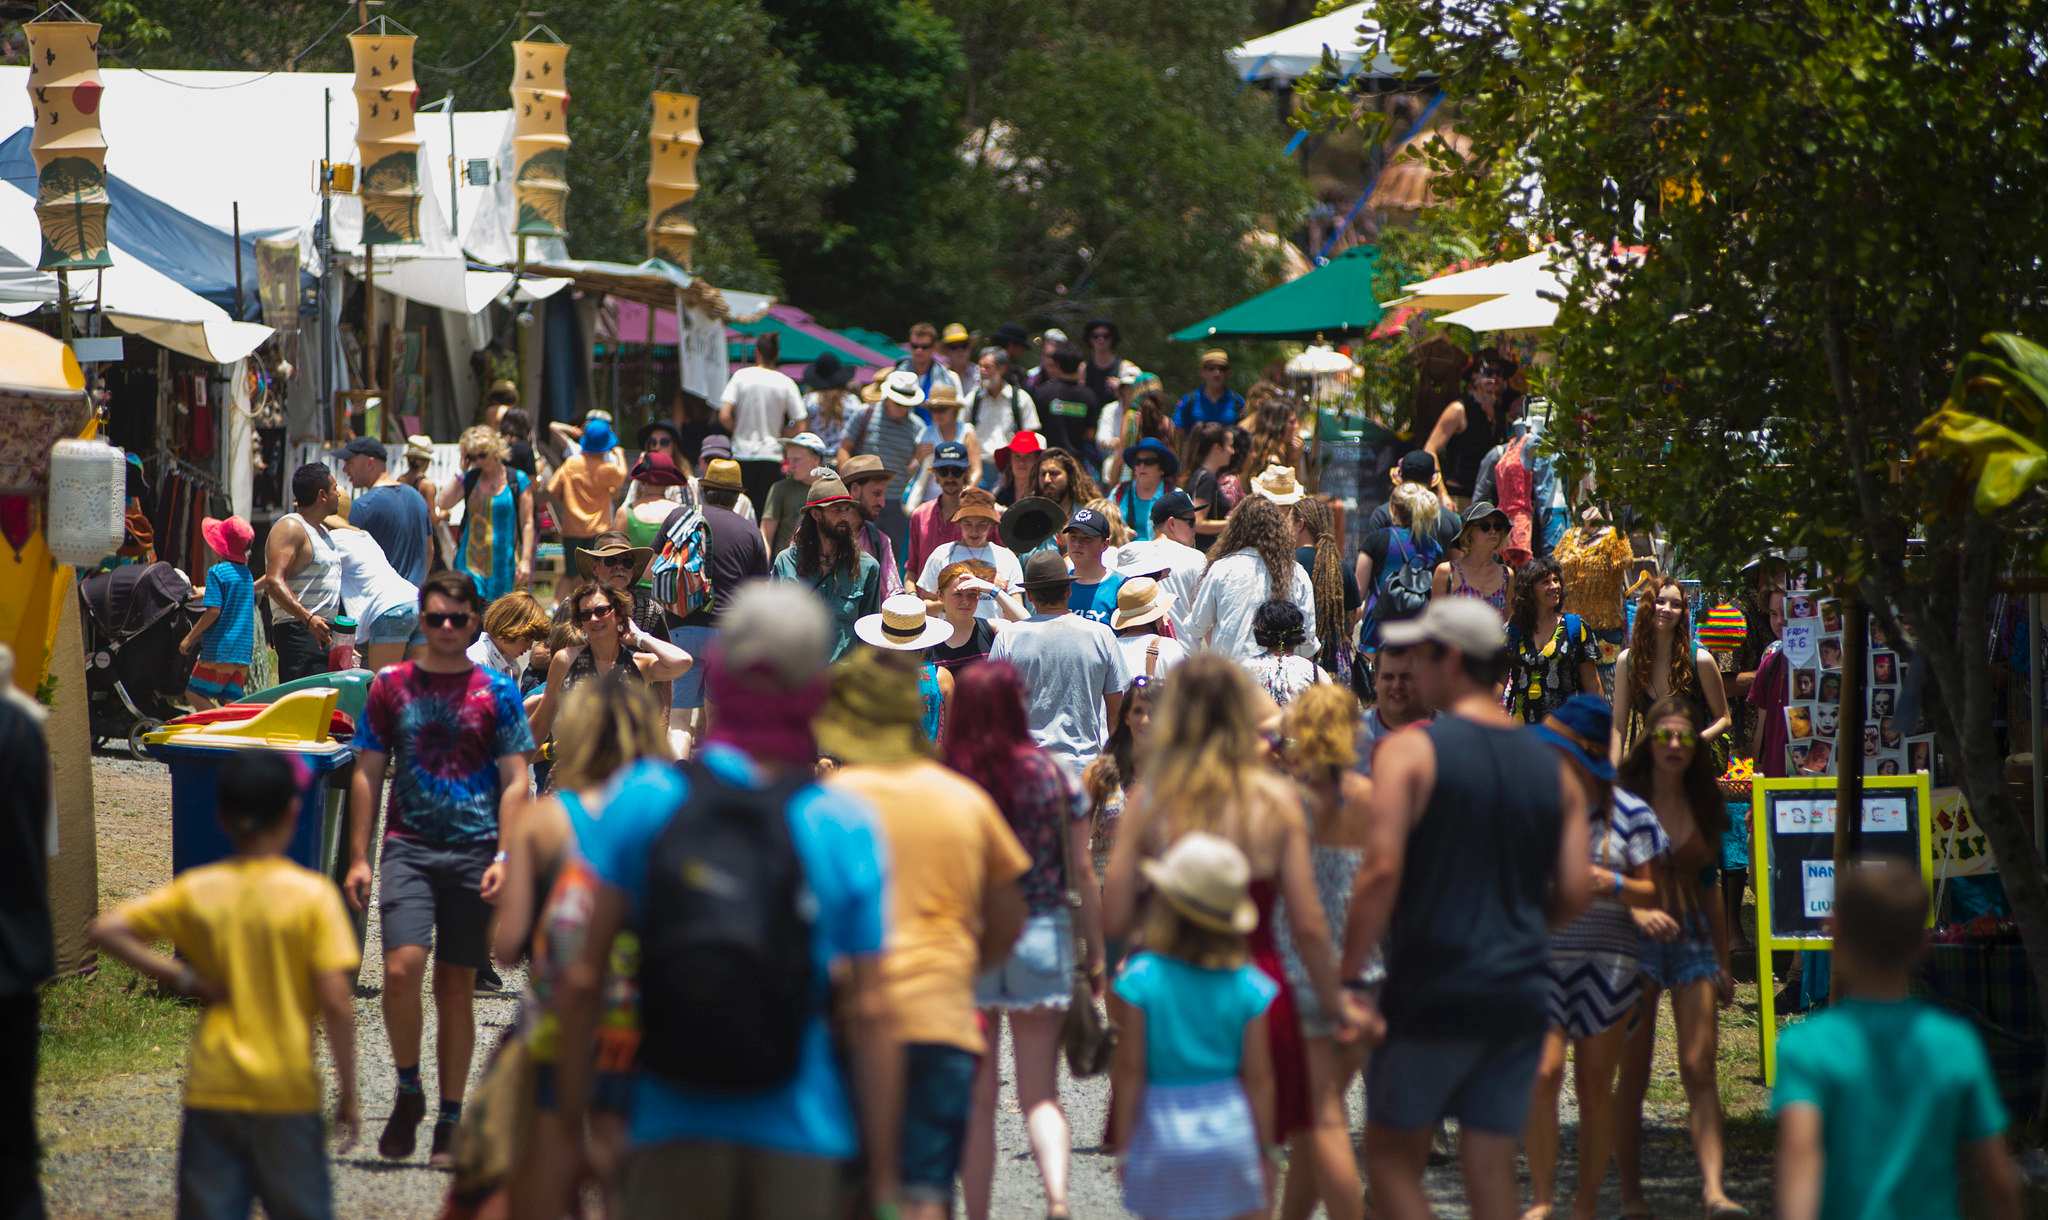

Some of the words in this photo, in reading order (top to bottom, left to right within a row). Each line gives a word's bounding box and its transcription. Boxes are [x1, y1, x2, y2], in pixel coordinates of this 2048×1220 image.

[1786, 627, 1809, 637] FROM
[1787, 637, 1806, 652] $6
[1811, 901, 1834, 912] LIV
